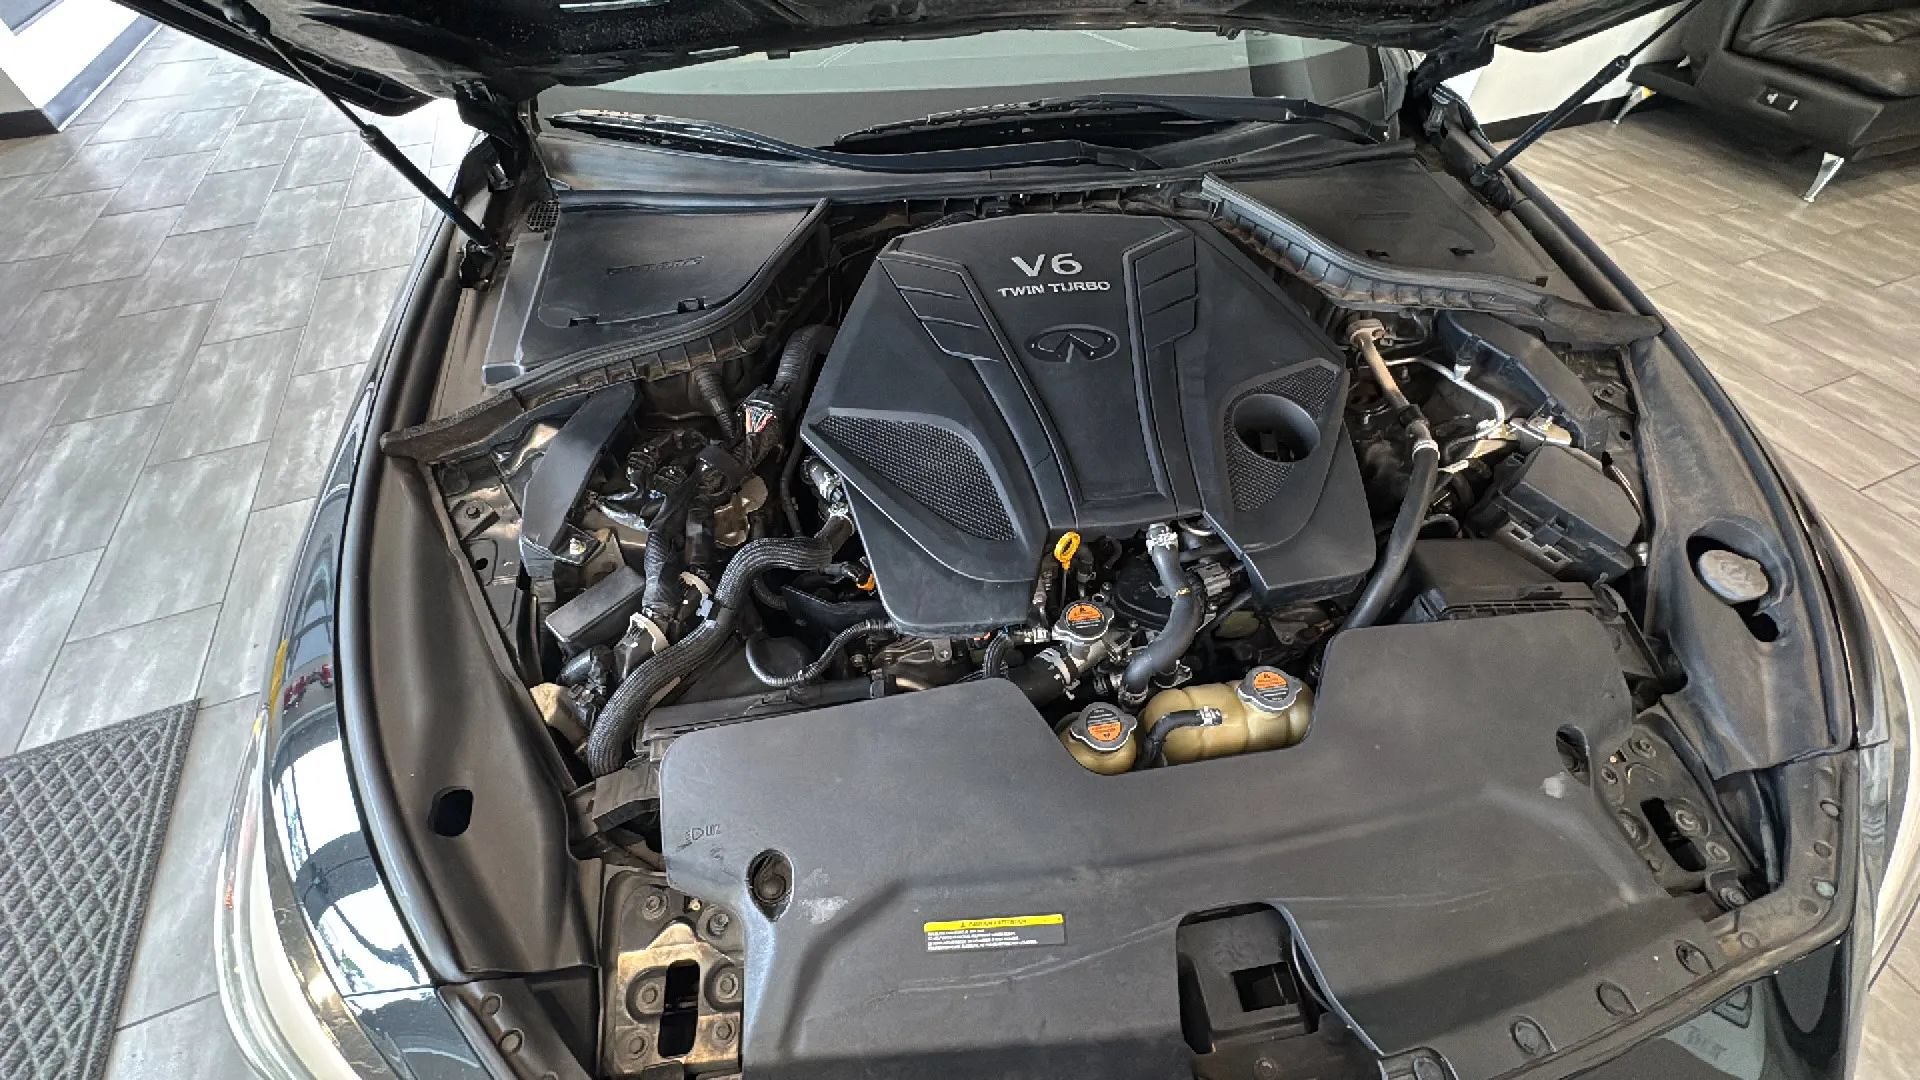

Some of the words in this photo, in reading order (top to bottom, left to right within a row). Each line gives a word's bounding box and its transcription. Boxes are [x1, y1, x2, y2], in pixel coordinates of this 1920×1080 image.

[1010, 252, 1083, 277] V6
[997, 284, 1045, 297] TWIN
[1047, 281, 1111, 293] TURBO
